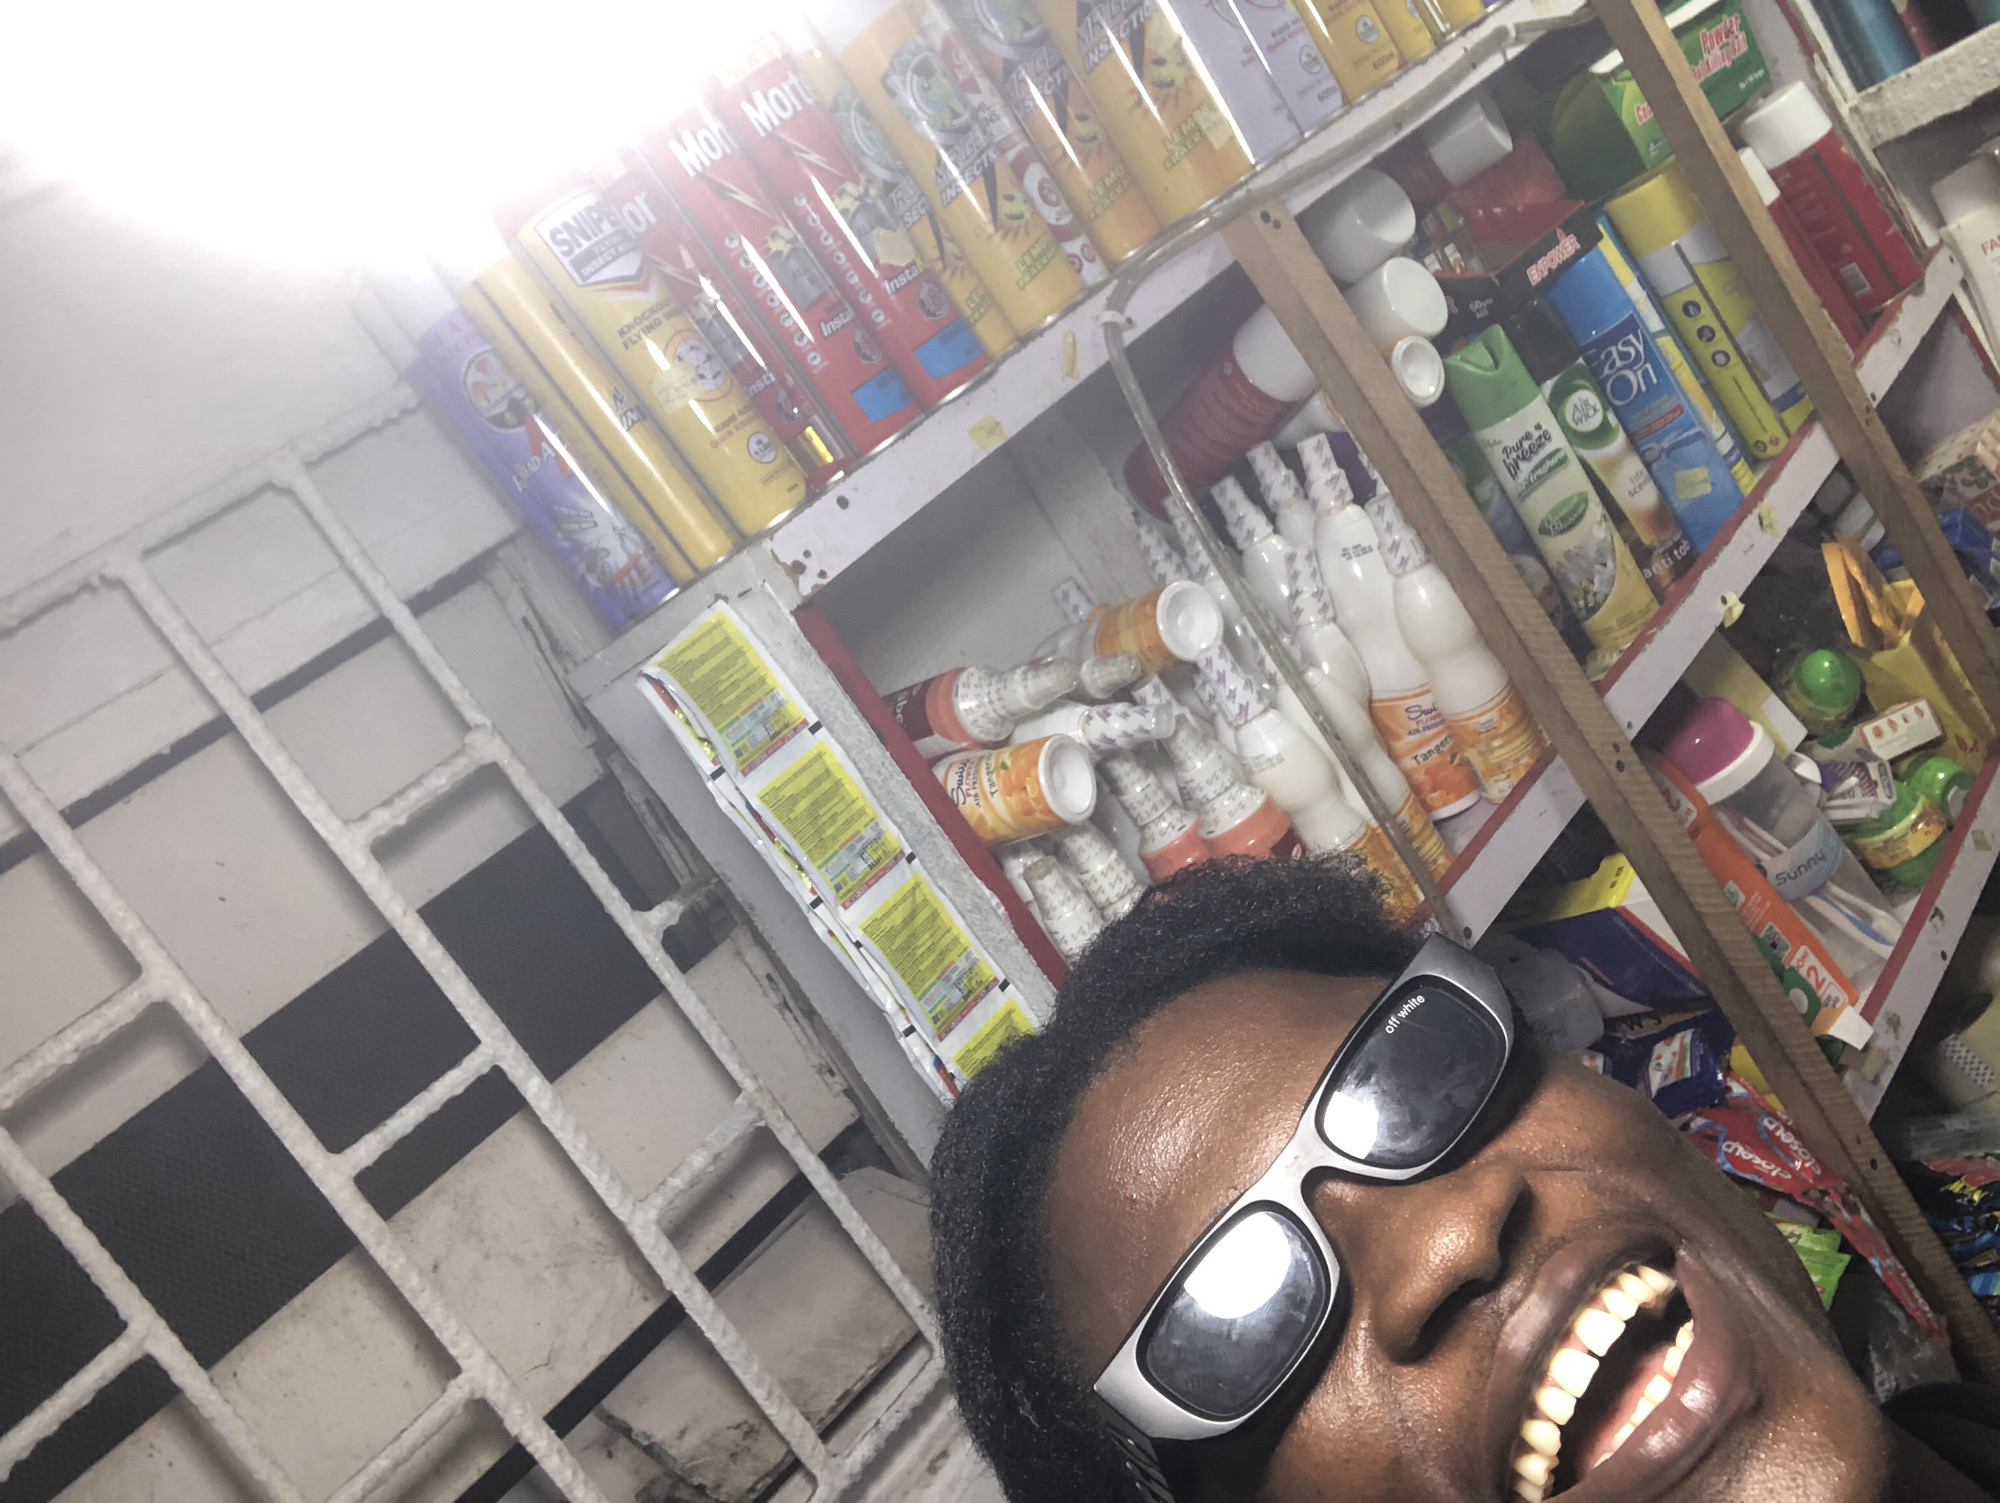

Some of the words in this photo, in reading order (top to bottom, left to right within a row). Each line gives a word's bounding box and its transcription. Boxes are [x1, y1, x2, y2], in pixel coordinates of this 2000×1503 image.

[1698, 10, 1743, 53] Powder
[1603, 363, 1657, 407] On
[1502, 428, 1532, 460] Pure
[1506, 427, 1552, 478] breeze
[1642, 550, 1672, 579] anti
[1385, 1016, 1401, 1034] off
[1397, 995, 1425, 1018] white
[1721, 1140, 1792, 1179] closeup
[1762, 1117, 1822, 1176] closeup
